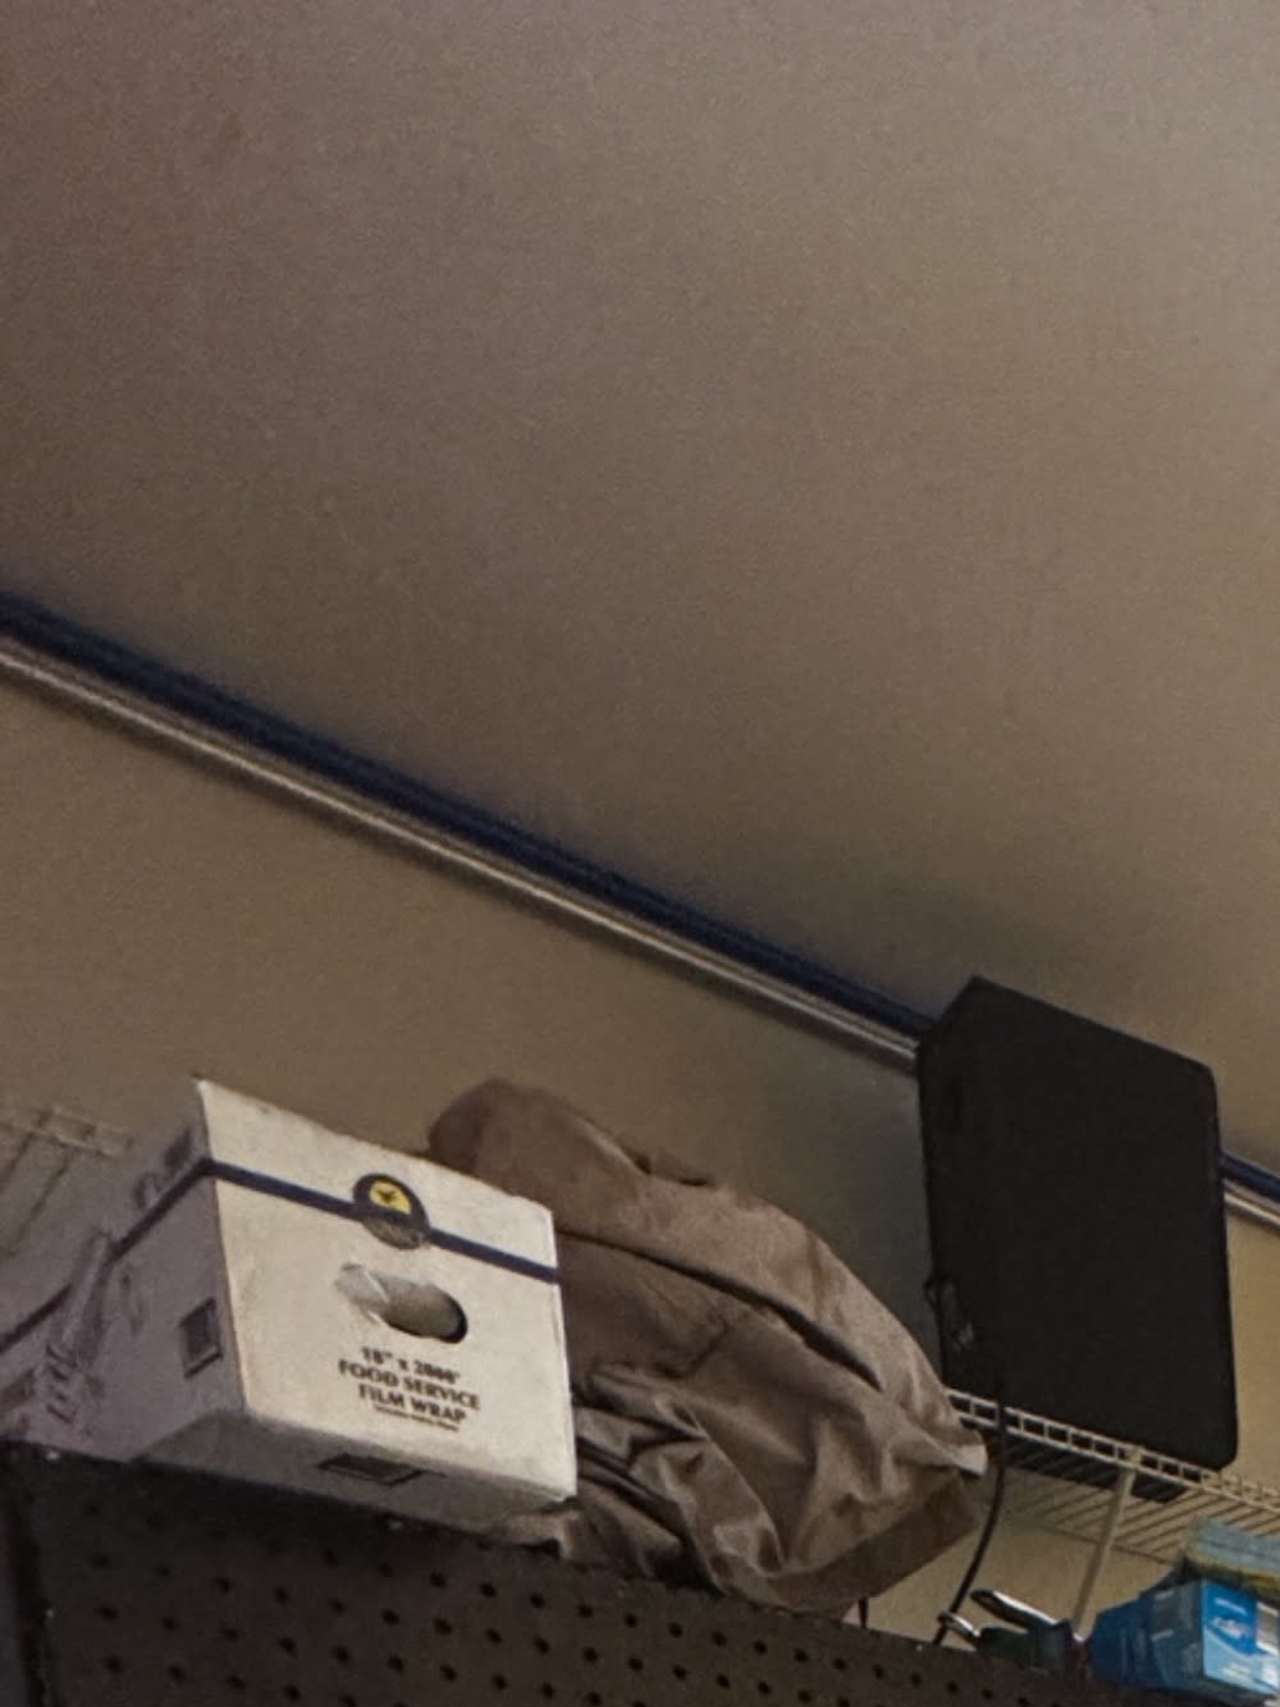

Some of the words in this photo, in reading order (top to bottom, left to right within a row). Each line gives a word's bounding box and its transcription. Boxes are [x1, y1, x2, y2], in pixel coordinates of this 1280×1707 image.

[337, 1358, 399, 1387] FOOD
[403, 1376, 480, 1411] SERVICE
[358, 1382, 405, 1409] FILM
[409, 1396, 467, 1424] WRAP
